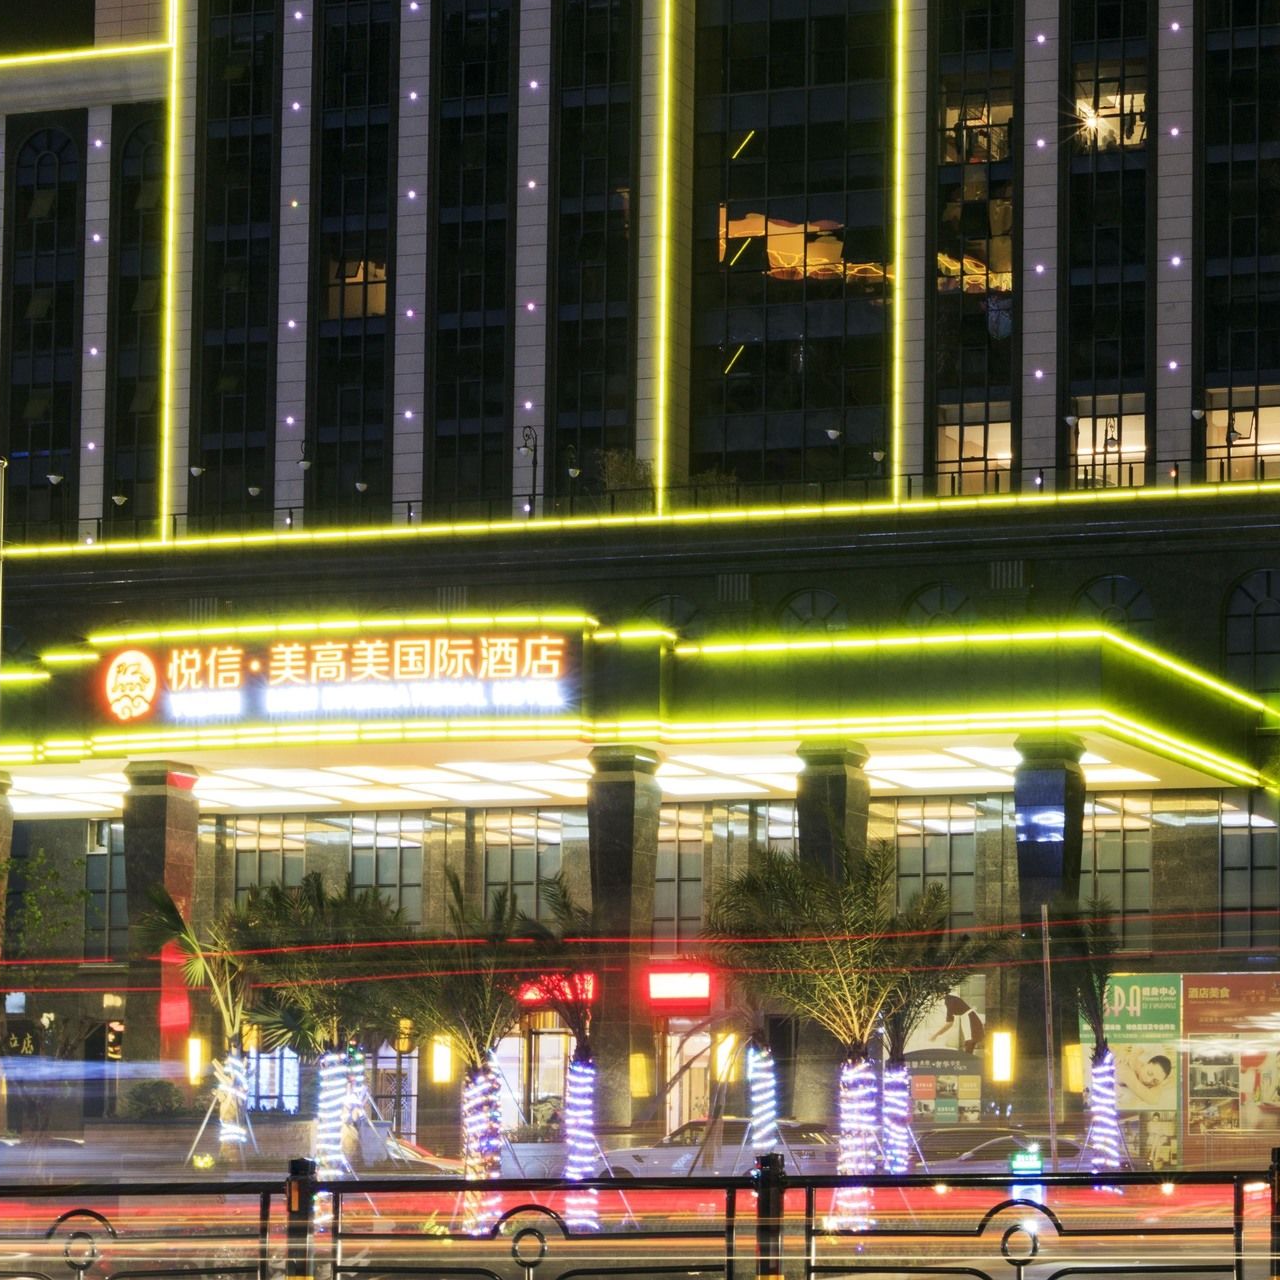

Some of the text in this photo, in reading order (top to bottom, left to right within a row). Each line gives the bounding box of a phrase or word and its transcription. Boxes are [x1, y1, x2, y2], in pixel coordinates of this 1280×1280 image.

[167, 635, 565, 691] 悦信·美高美国际酒店
